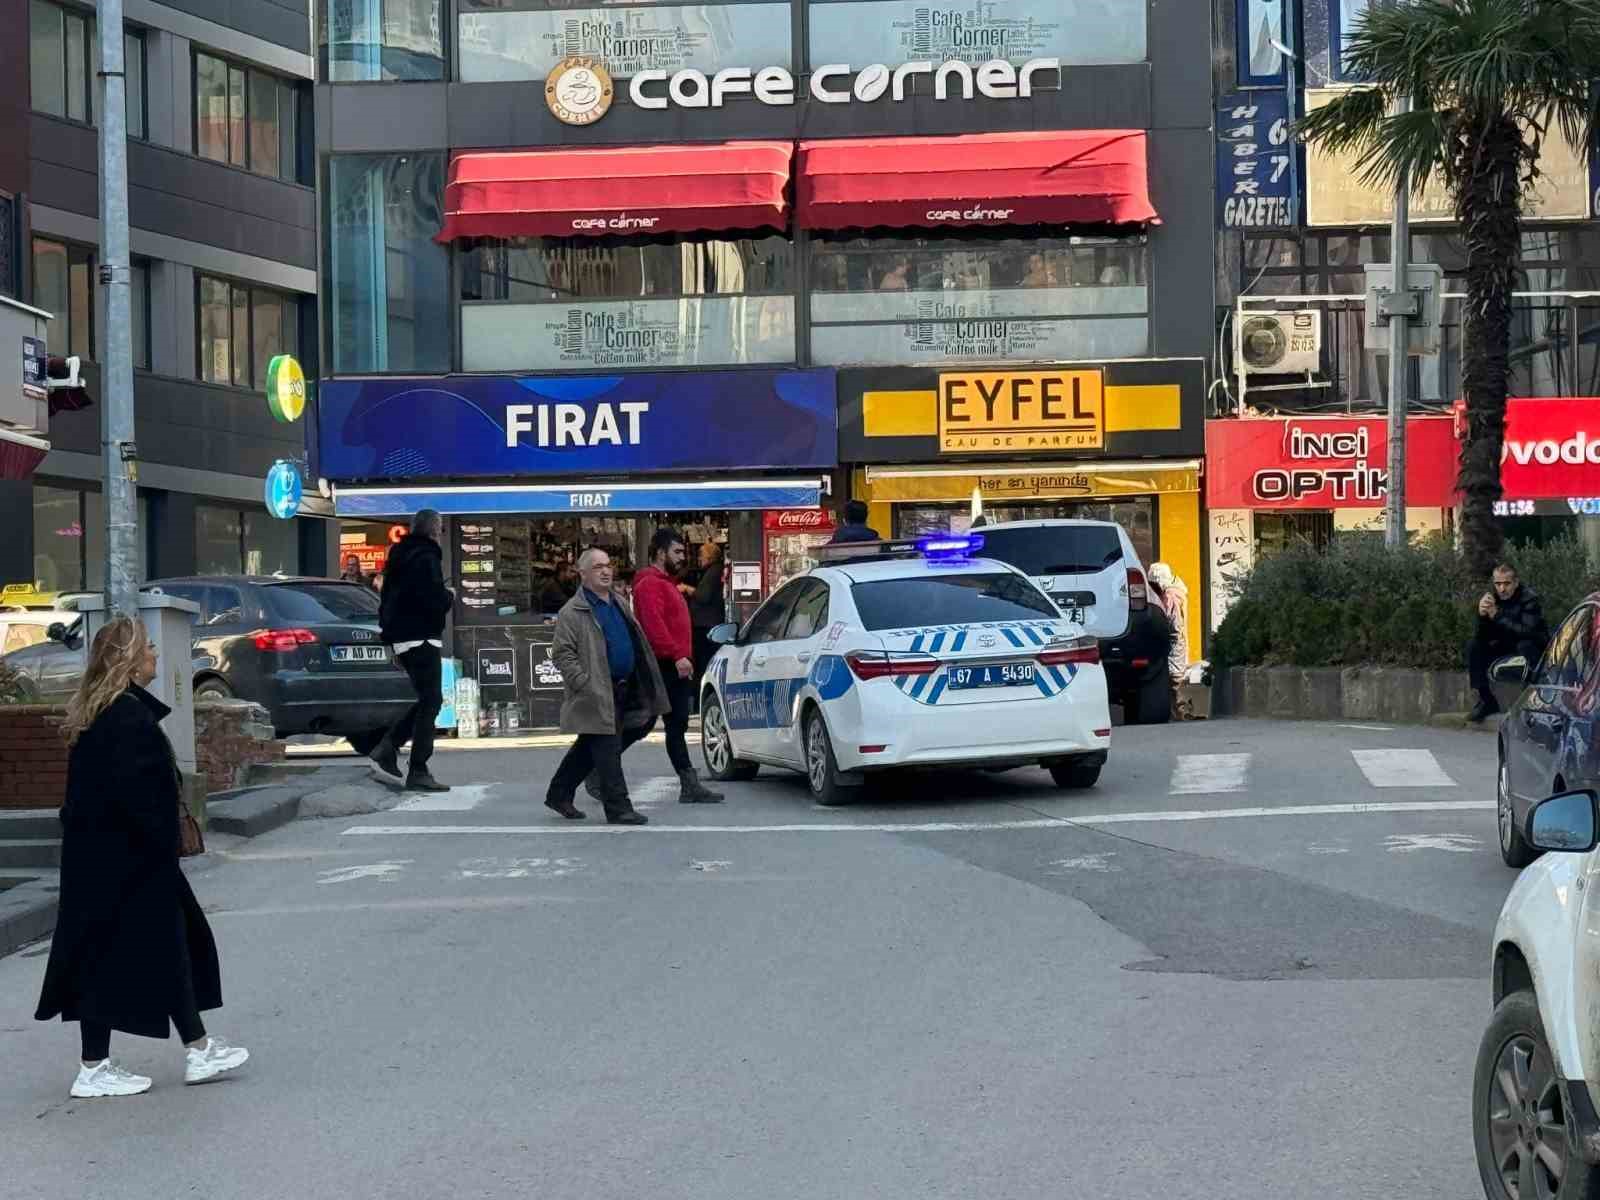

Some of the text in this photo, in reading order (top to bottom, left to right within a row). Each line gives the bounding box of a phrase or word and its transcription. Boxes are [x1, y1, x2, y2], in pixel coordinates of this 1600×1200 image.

[953, 26, 1007, 46] Corner
[605, 327, 661, 347] Corner
[945, 377, 1095, 422] EYFEL
[506, 402, 649, 448] FIRAT
[946, 435, 1098, 447] EAU DE PARFUM
[569, 493, 613, 507] FIRAT
[984, 668, 991, 682] A
